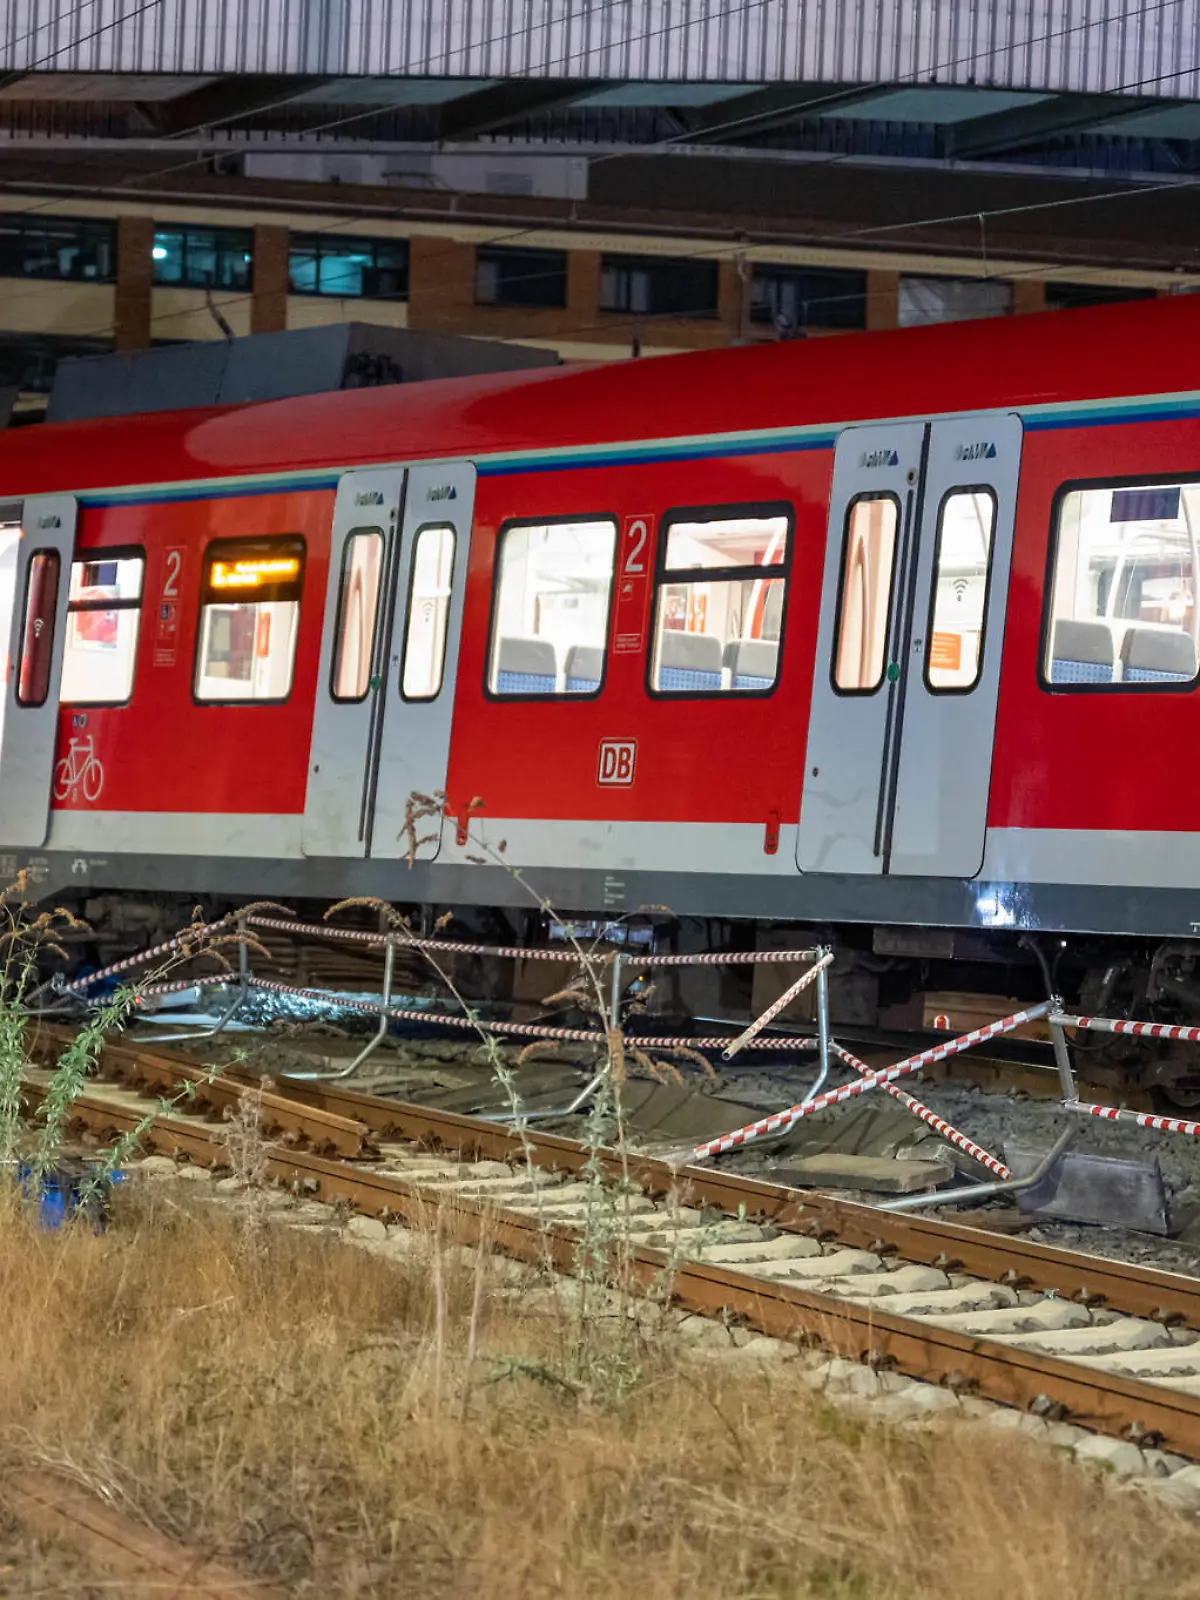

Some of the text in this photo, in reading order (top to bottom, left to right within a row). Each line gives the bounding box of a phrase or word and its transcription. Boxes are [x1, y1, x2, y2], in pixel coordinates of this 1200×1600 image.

[625, 520, 647, 572] 2
[163, 551, 181, 596] 2
[602, 747, 631, 779] DB
